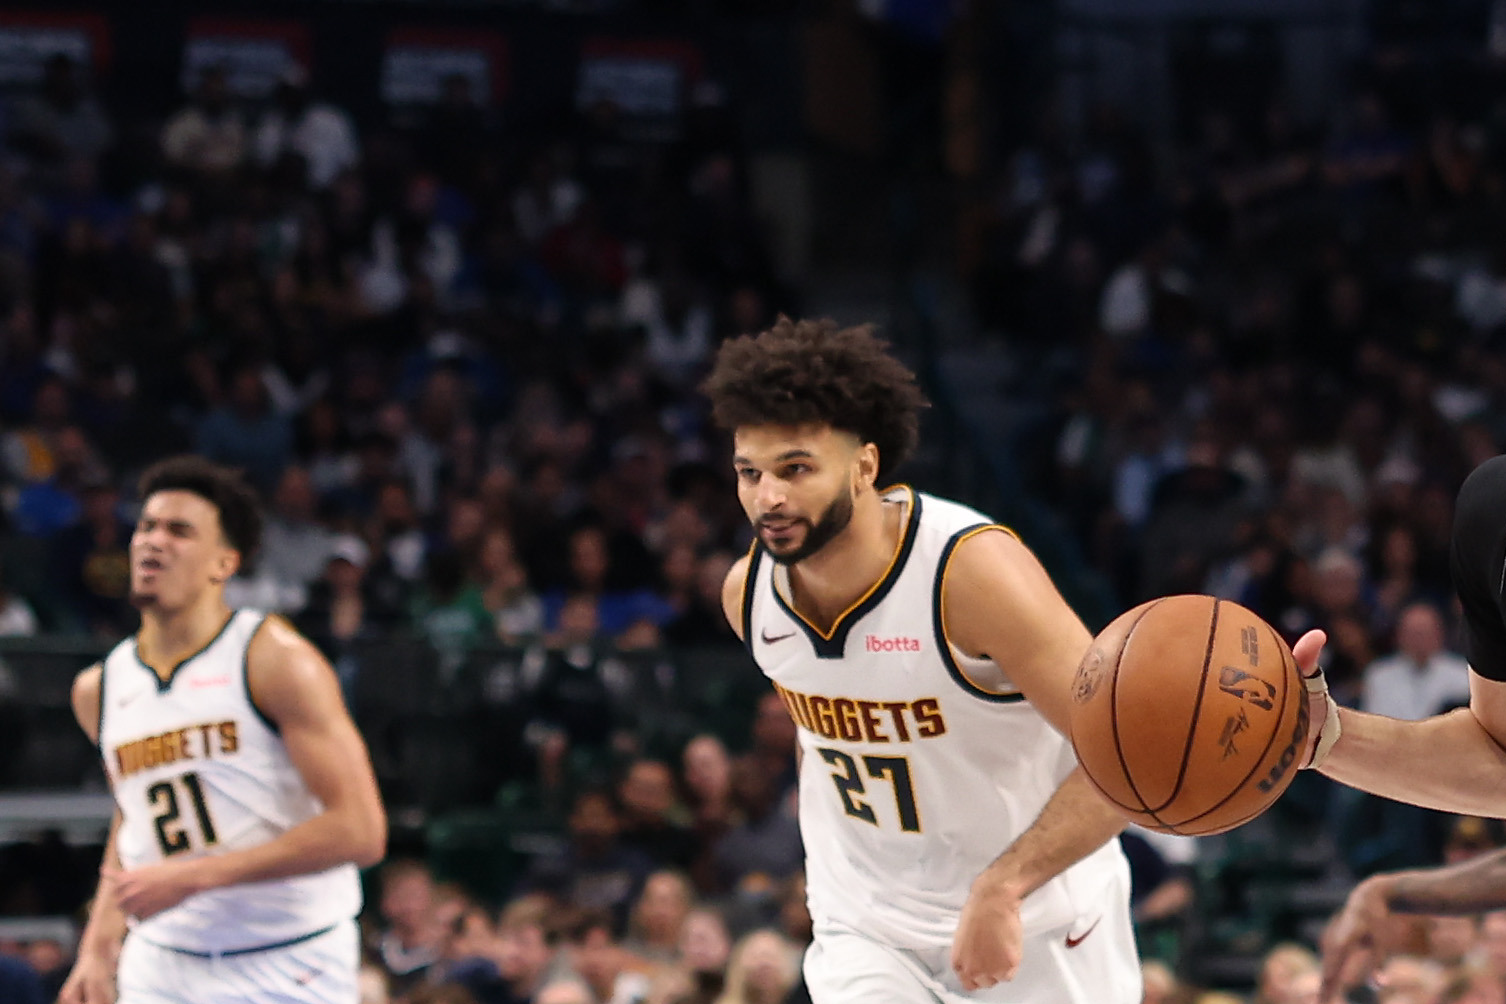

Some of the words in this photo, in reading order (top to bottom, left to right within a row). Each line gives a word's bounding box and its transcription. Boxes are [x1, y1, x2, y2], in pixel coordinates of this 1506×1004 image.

[866, 635, 920, 652] ibotta
[773, 681, 947, 742] NUGGETS
[146, 771, 217, 858] 21
[815, 746, 922, 834] 27
